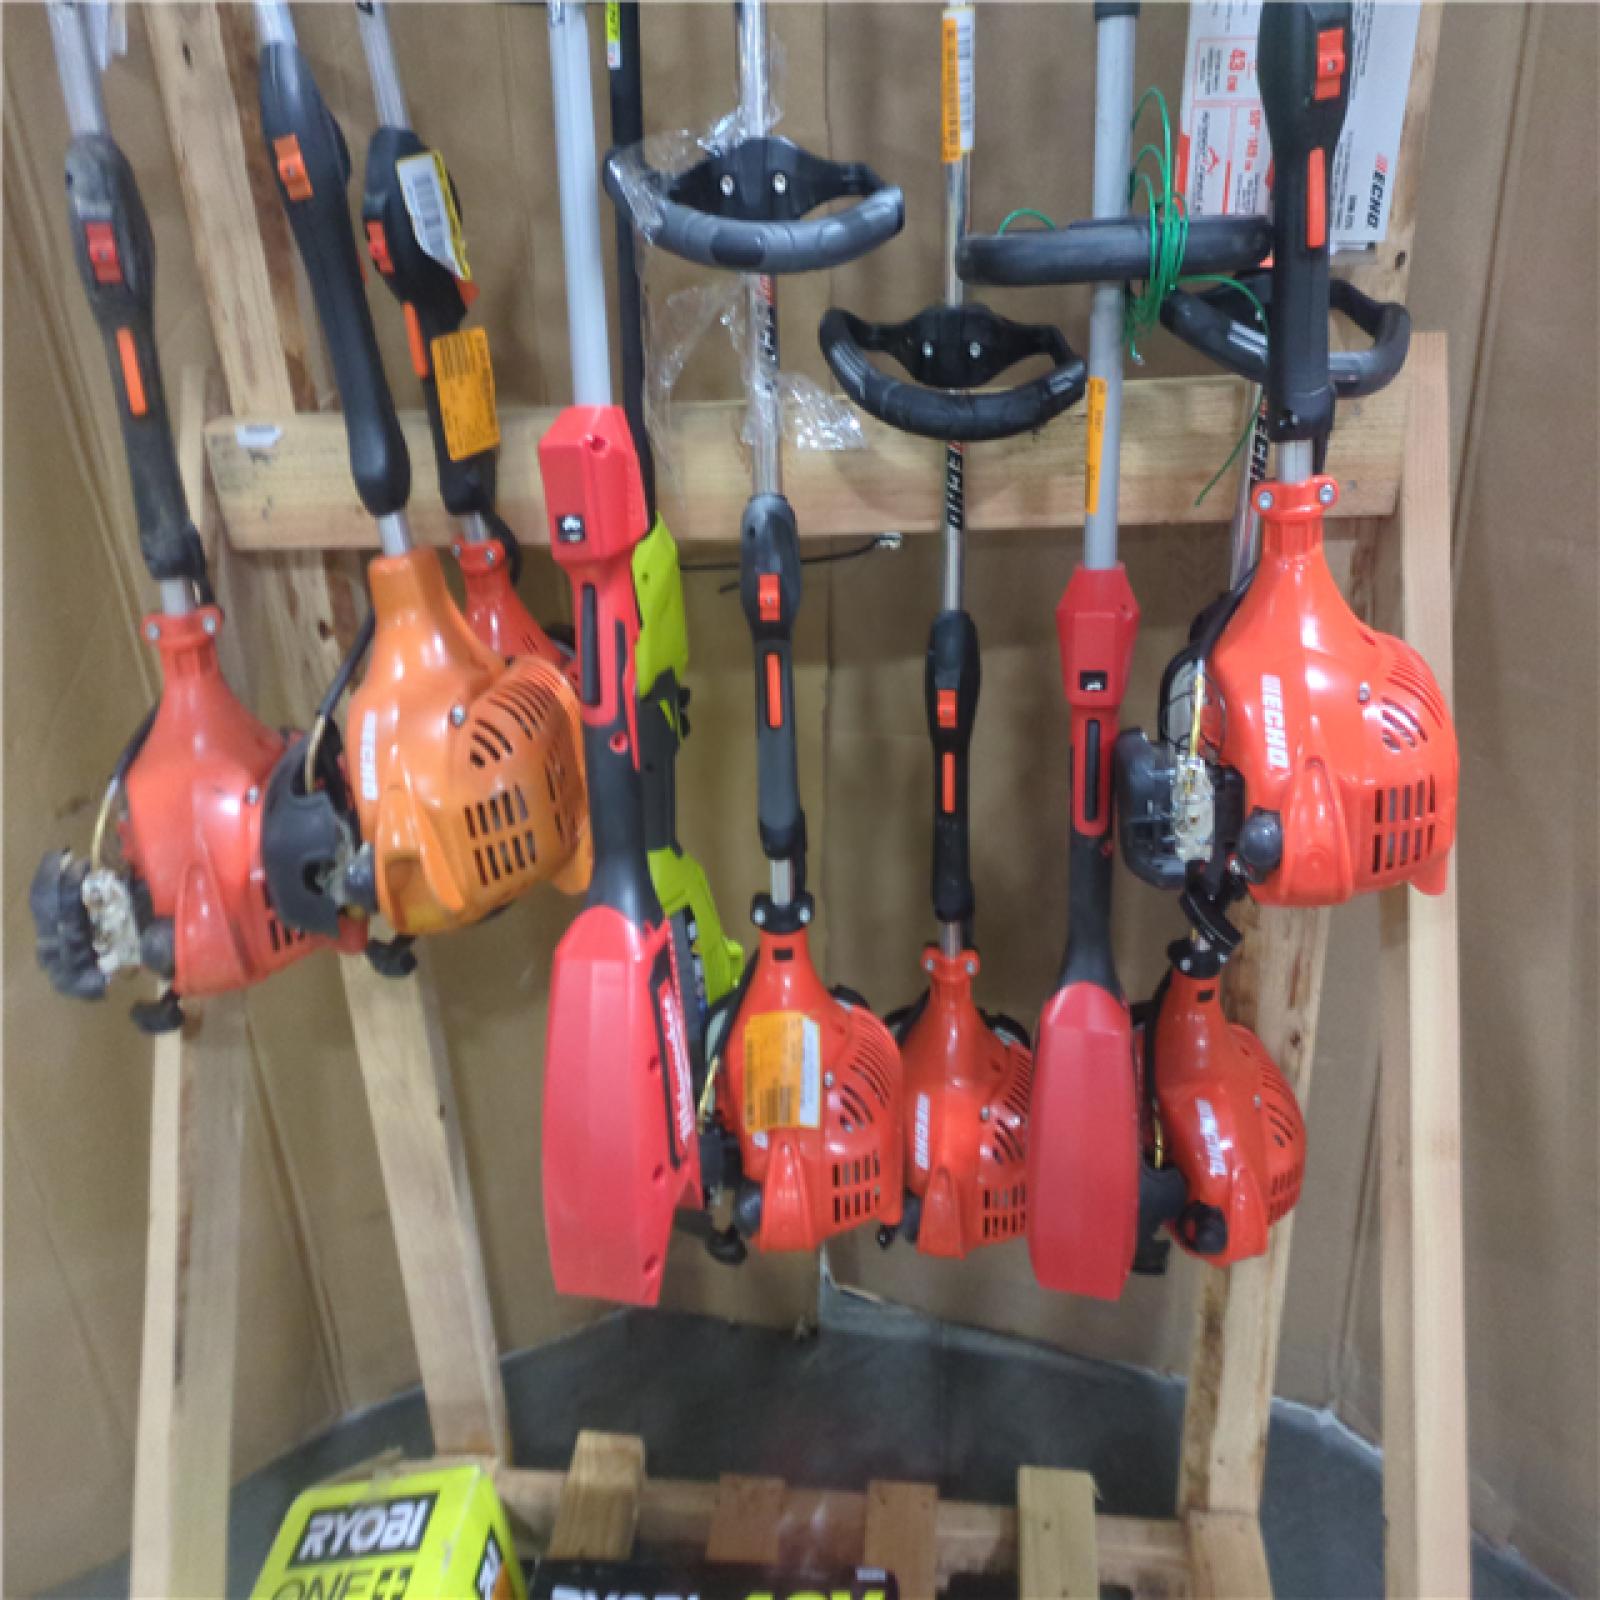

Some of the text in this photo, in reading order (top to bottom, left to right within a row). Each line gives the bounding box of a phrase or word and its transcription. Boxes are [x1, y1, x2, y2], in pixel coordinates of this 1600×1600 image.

[1367, 169, 1386, 230] ECHO
[946, 447, 963, 530] ECHO
[1262, 692, 1288, 772] ECHO
[298, 1498, 430, 1560] RYOBI
